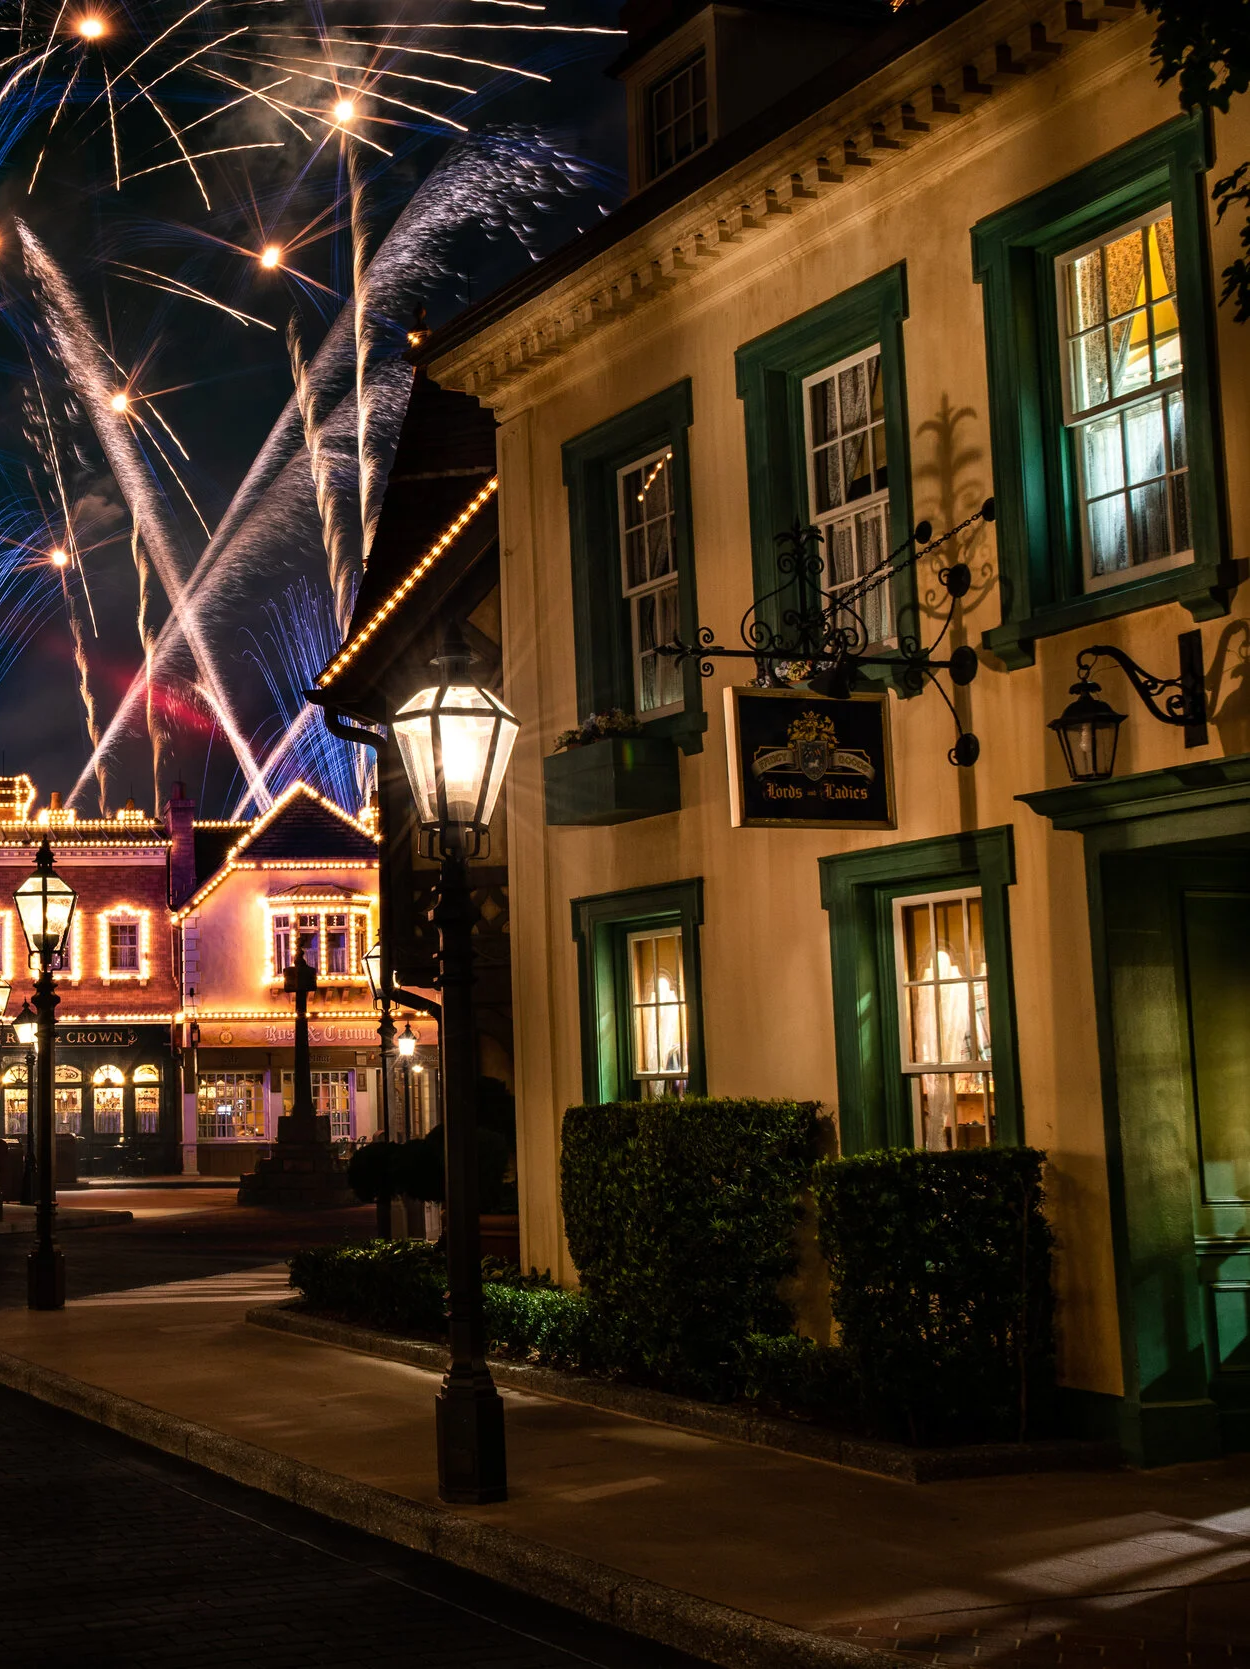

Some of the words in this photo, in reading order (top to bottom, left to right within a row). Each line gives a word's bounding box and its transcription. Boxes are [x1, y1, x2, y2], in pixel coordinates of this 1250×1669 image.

[765, 782, 803, 799] Lords
[822, 783, 868, 800] Ladies
[66, 1032, 123, 1043] CROWN
[264, 1024, 296, 1042] Ros
[323, 1025, 377, 1042] Crown
